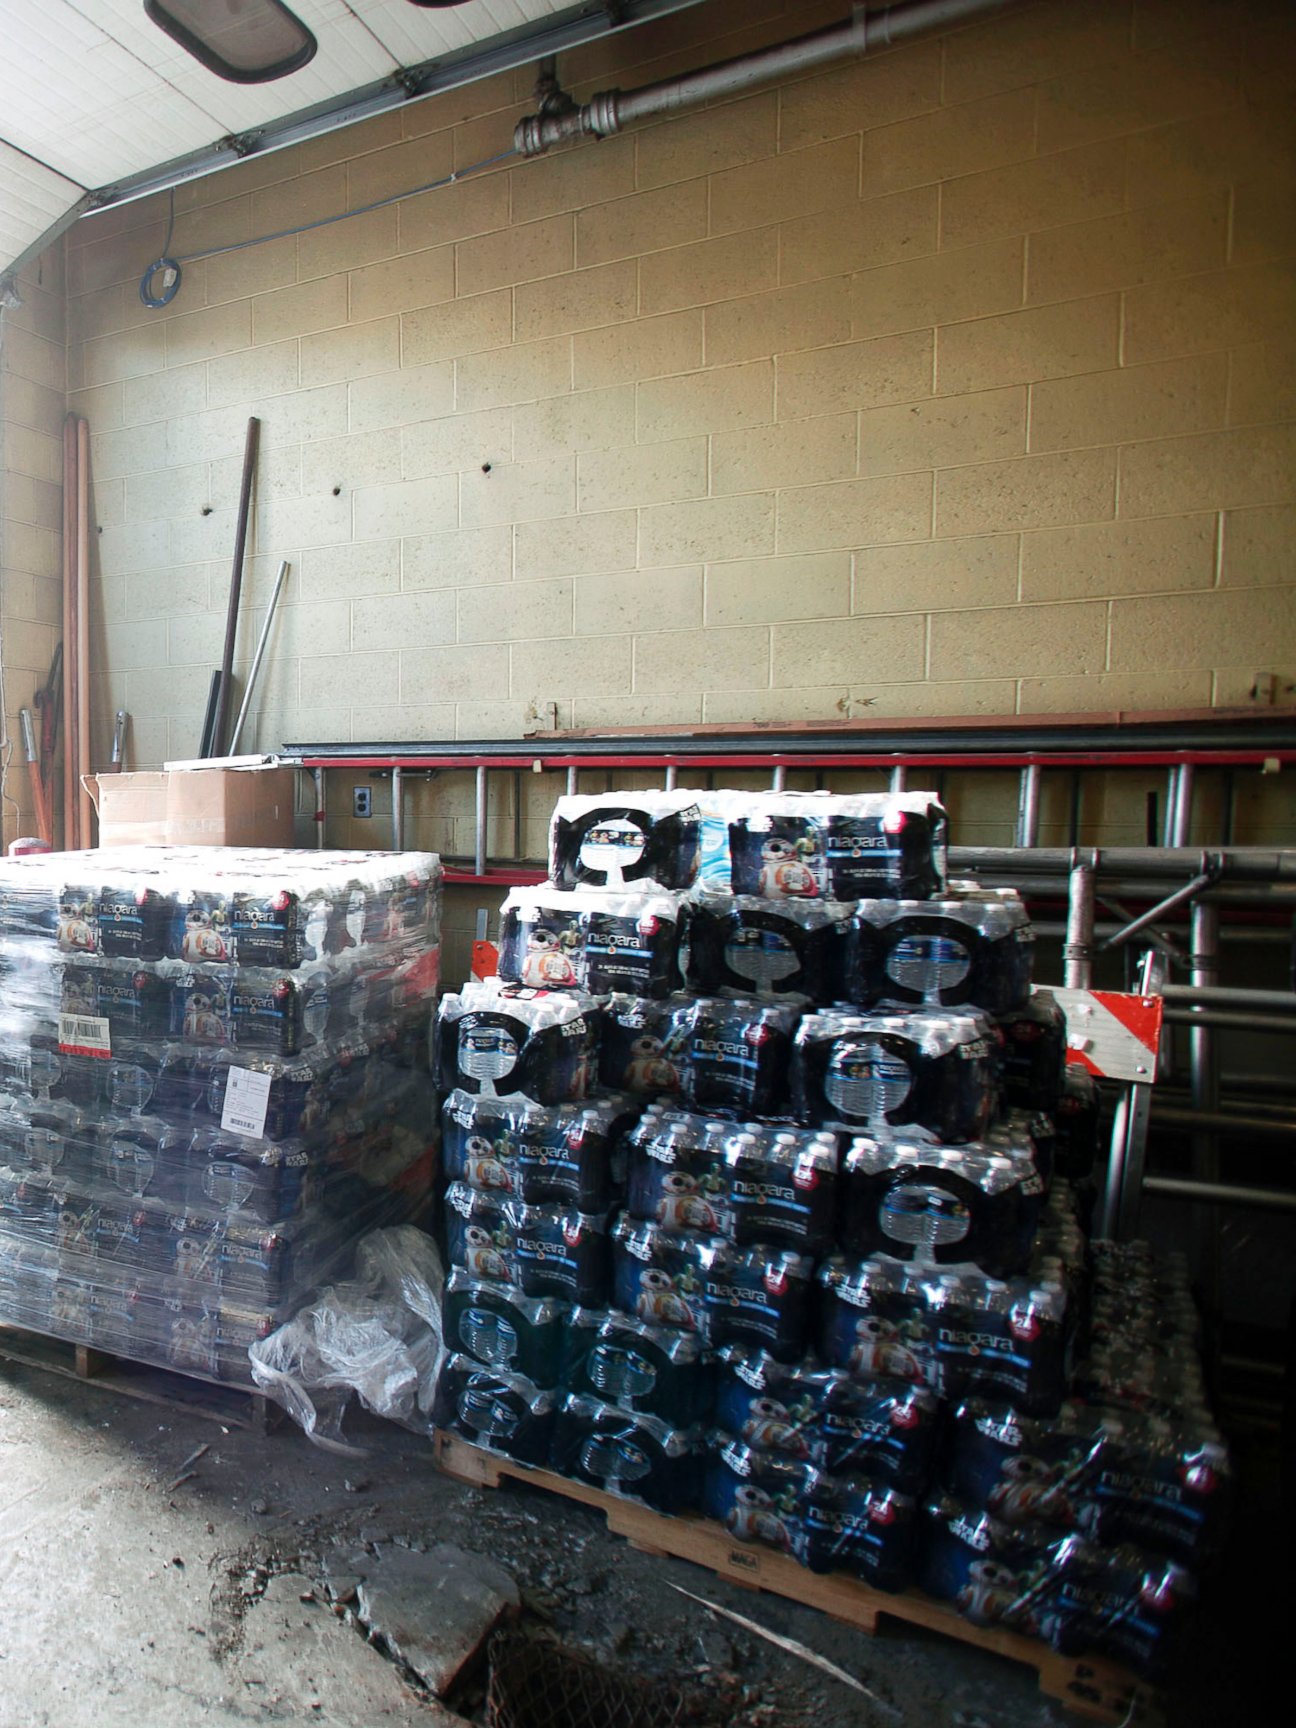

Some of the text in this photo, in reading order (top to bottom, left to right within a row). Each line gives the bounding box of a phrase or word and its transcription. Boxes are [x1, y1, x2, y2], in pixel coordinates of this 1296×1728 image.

[828, 835, 889, 853] niagara
[98, 901, 138, 919] niagara
[234, 909, 275, 926] niagara
[588, 932, 641, 950] niagara
[98, 983, 136, 1001] niagara
[234, 993, 275, 1012] niagara
[695, 1037, 750, 1058] niagara
[519, 1143, 570, 1161] niagara
[733, 1180, 796, 1202] niagara
[517, 1237, 567, 1257] niagara
[707, 1281, 767, 1304] niagara
[939, 1328, 1014, 1351] niagara
[826, 1412, 891, 1436] niagara
[808, 1505, 869, 1530] niagara
